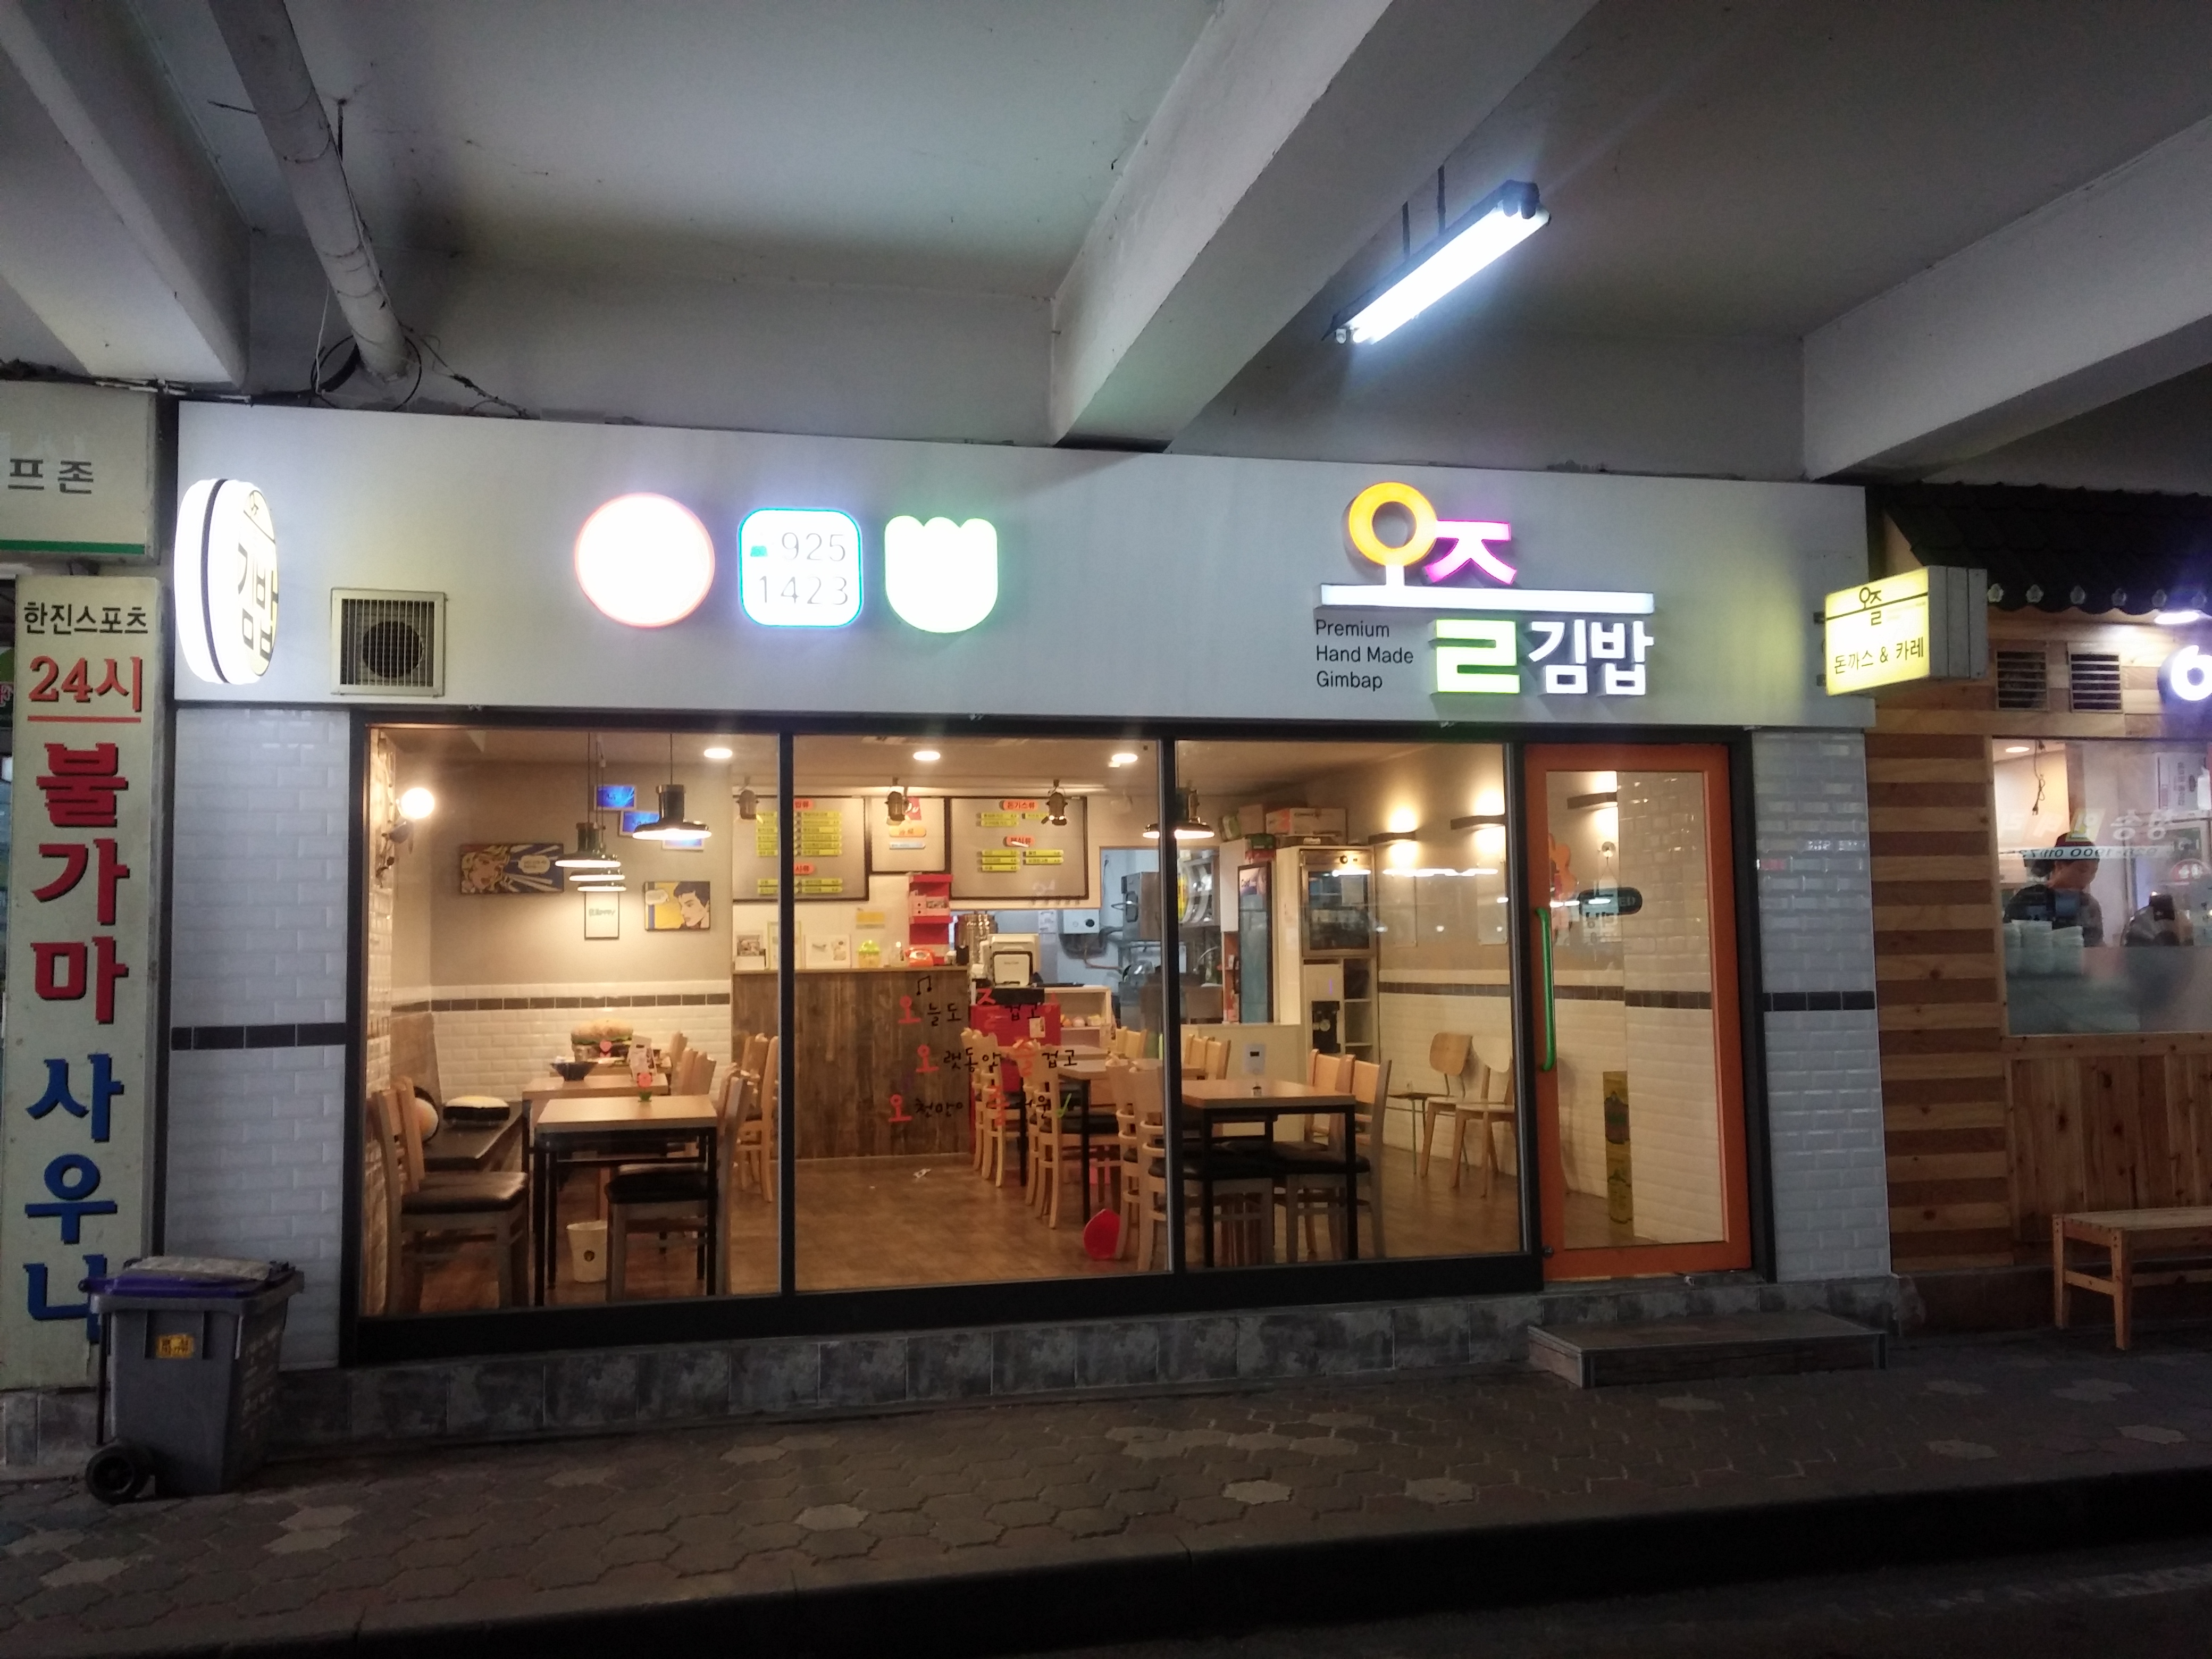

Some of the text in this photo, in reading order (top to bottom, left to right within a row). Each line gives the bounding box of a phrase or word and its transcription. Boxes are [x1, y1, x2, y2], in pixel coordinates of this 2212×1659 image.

[781, 532, 847, 562] 925
[237, 542, 279, 663] 김밥
[759, 575, 849, 606] 1423
[24, 601, 148, 636] 한진스포츠
[1316, 619, 1390, 638] Premium
[1316, 646, 1414, 664] Hand Made
[1528, 618, 1655, 696] 김밥
[1834, 636, 1924, 674] 돈까스 & 카레
[28, 655, 143, 713] 24시
[1316, 671, 1383, 691] Gimbap
[898, 995, 961, 1027] 오늘도
[24, 742, 130, 1345] 불가마 사우나
